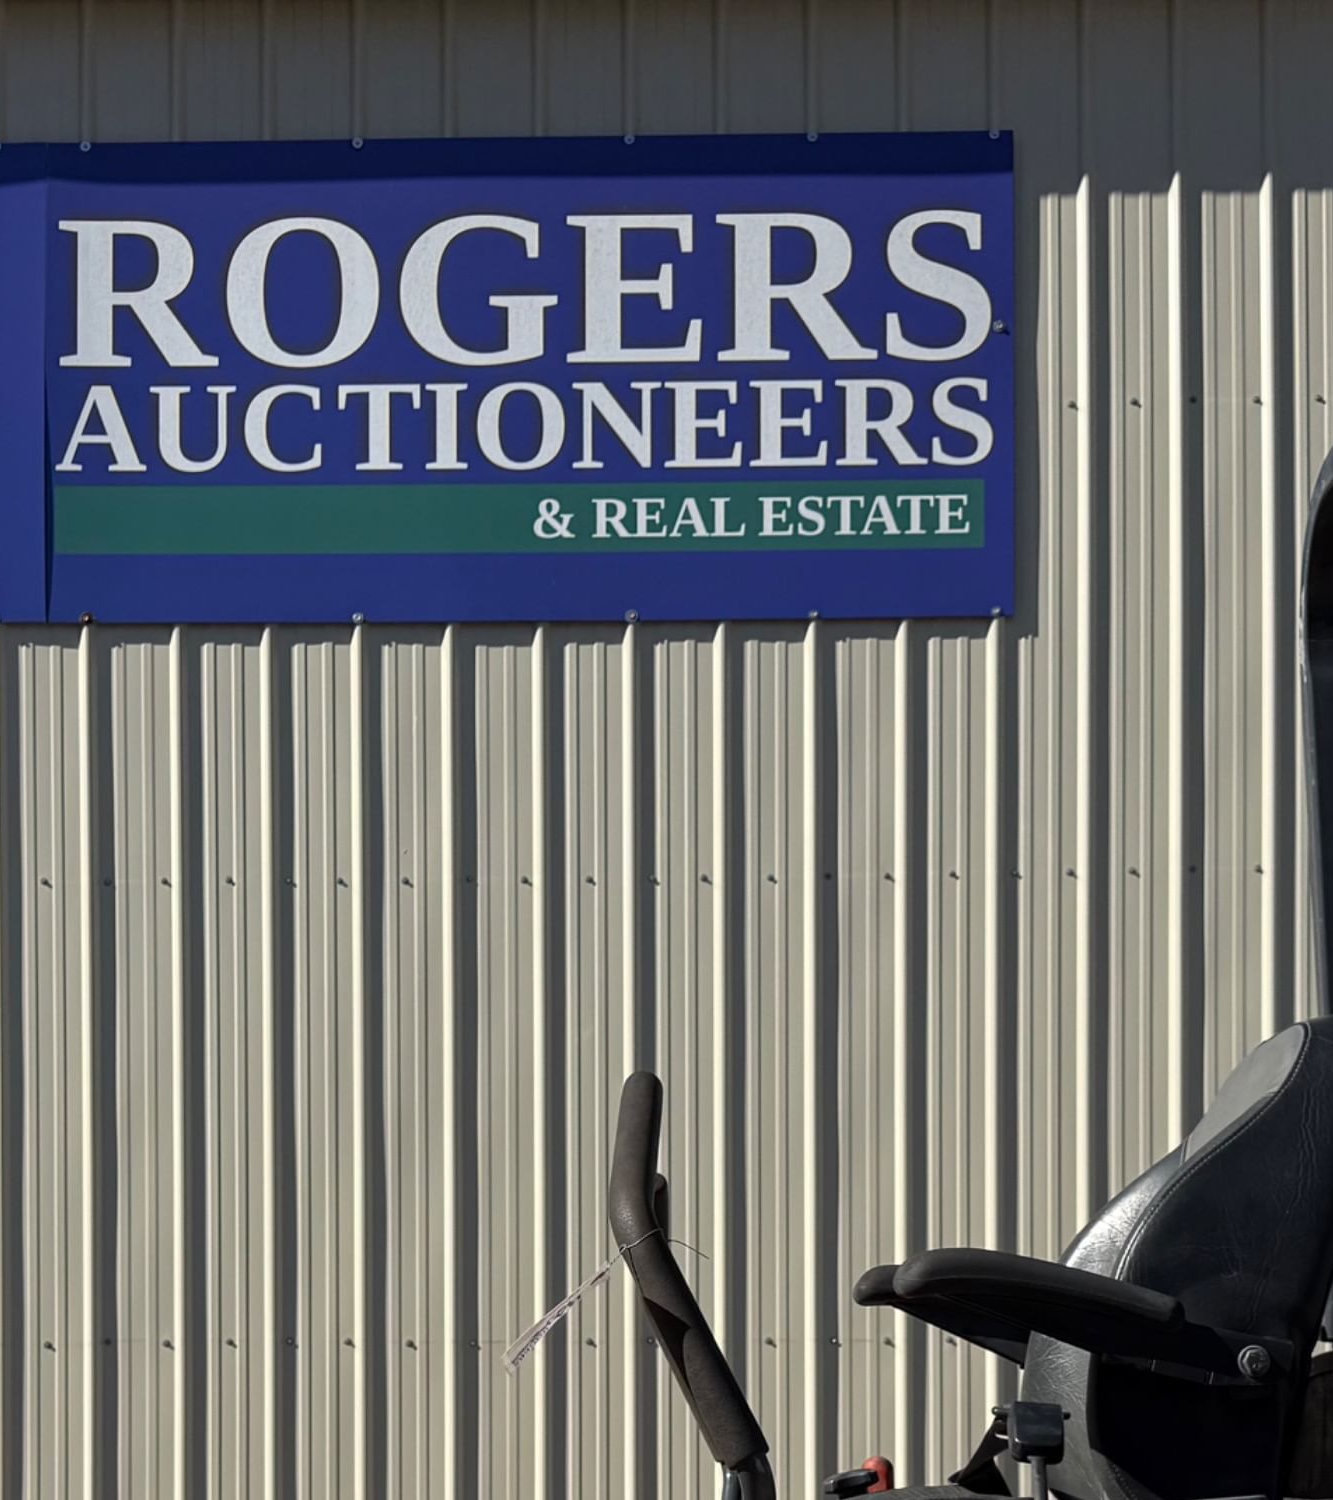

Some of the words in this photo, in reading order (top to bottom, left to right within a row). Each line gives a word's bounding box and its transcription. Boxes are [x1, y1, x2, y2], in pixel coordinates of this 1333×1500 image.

[59, 208, 993, 370] ROGERS
[56, 375, 993, 475] AUCTIONEERS
[531, 495, 574, 537] &
[590, 494, 744, 538] REAL
[757, 489, 972, 536] ESTATE
